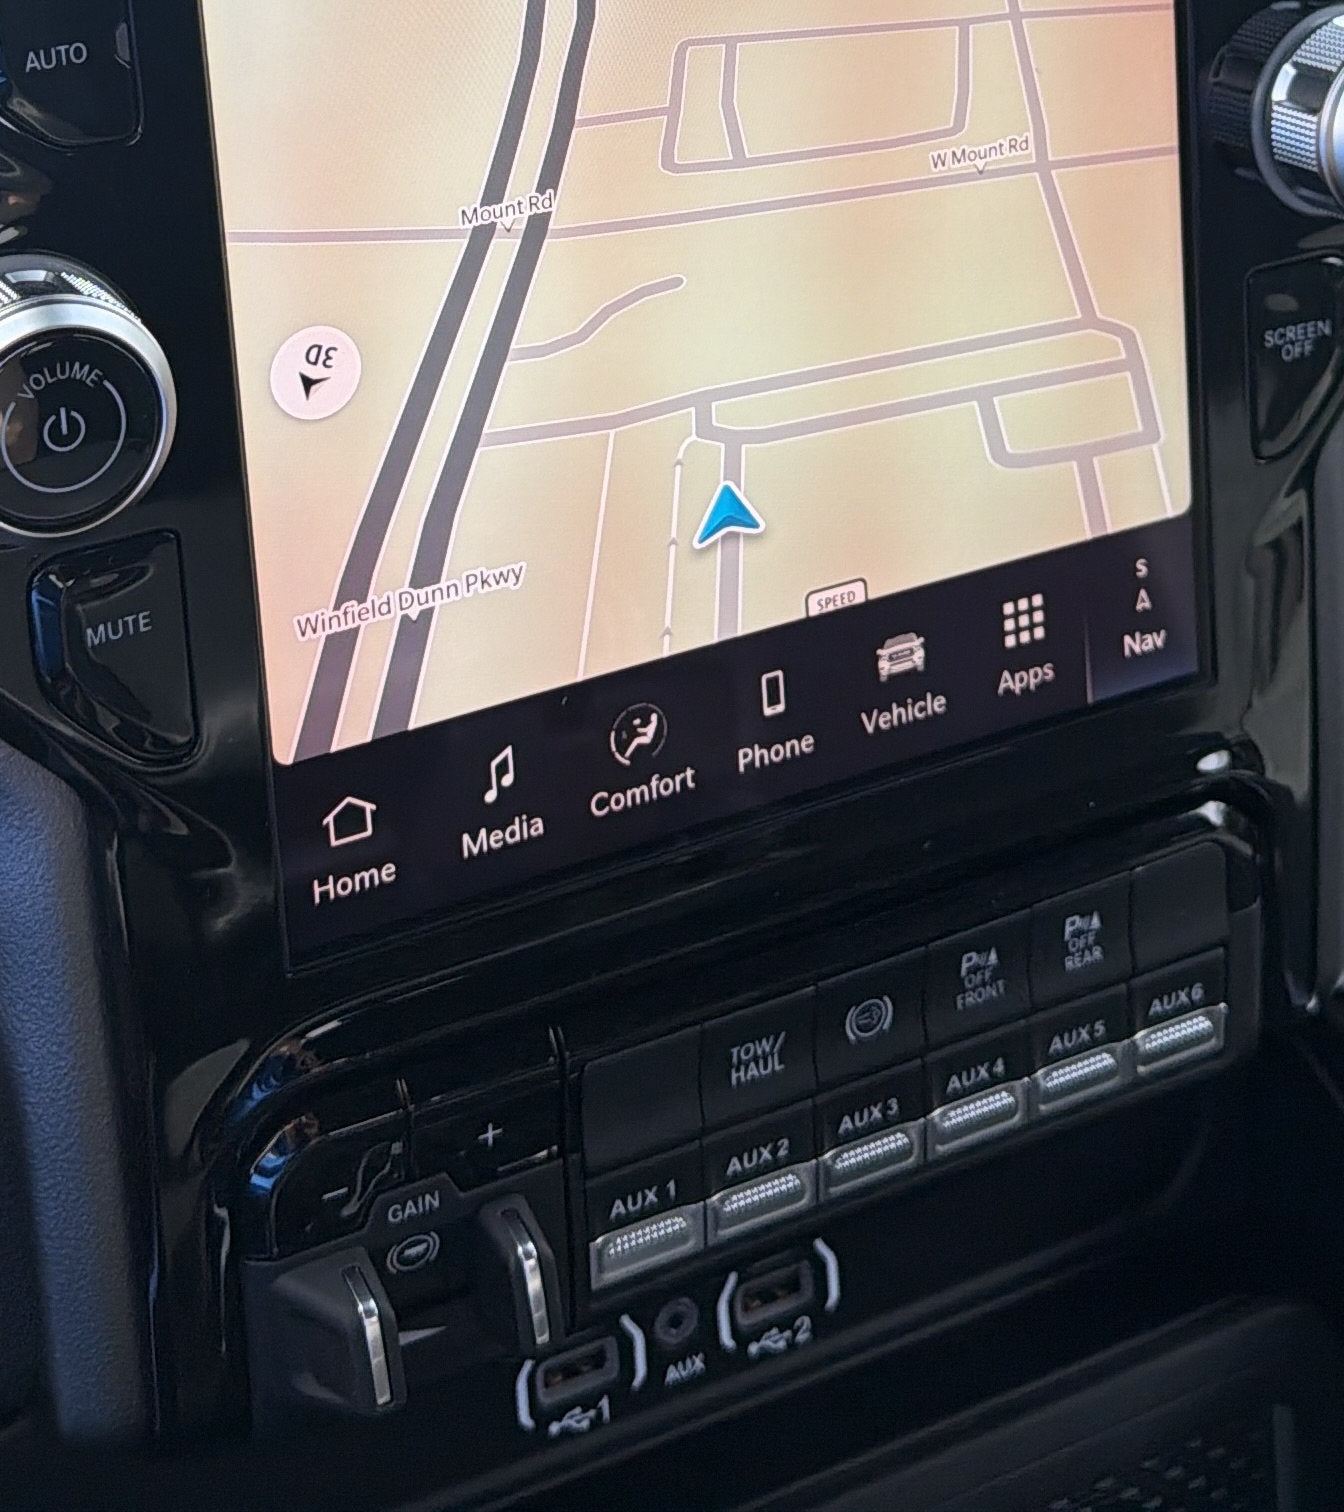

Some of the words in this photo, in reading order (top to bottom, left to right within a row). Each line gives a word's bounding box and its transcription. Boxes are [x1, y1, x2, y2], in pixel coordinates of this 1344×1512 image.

[25, 42, 87, 73] AUTO
[931, 152, 947, 168] W
[951, 143, 1004, 165] Mount
[1008, 136, 1029, 153] Rd
[461, 200, 524, 225] Mount
[529, 192, 553, 212] Rd
[1264, 319, 1333, 348] SCREEN
[1281, 339, 1313, 362] OFF
[305, 344, 338, 368] 3D
[17, 361, 103, 400] VOLUME
[296, 596, 391, 637] Winfield
[399, 583, 459, 611] Dunn
[465, 565, 523, 593] Pkwy
[816, 590, 856, 611] SPEED
[86, 610, 152, 648] MUTE
[1123, 629, 1167, 658] Nav
[998, 662, 1055, 697] Apps
[861, 691, 947, 735] Vehicle
[738, 732, 815, 774] Phone
[590, 766, 696, 818] Comfort
[462, 814, 545, 859] Media
[312, 861, 397, 905] Home
[1064, 945, 1104, 972] REAR
[1068, 930, 1097, 953] OFF
[964, 966, 994, 989] OFF
[956, 979, 1006, 1011] FRONT
[1148, 987, 1192, 1017] AUX
[1192, 982, 1205, 1002] 6
[1048, 1026, 1091, 1055] AUX
[1093, 1019, 1106, 1038] 5
[731, 1053, 785, 1087] HAUL
[946, 1063, 989, 1095] AUX
[992, 1057, 1005, 1077] 4
[838, 1103, 883, 1135] AUX
[886, 1097, 899, 1116] 3
[726, 1142, 773, 1176] AUX
[777, 1137, 791, 1158] 2
[387, 1190, 440, 1223] GAIN
[609, 1185, 659, 1220] AUX
[665, 1178, 677, 1201] 1
[793, 1315, 812, 1345] 2
